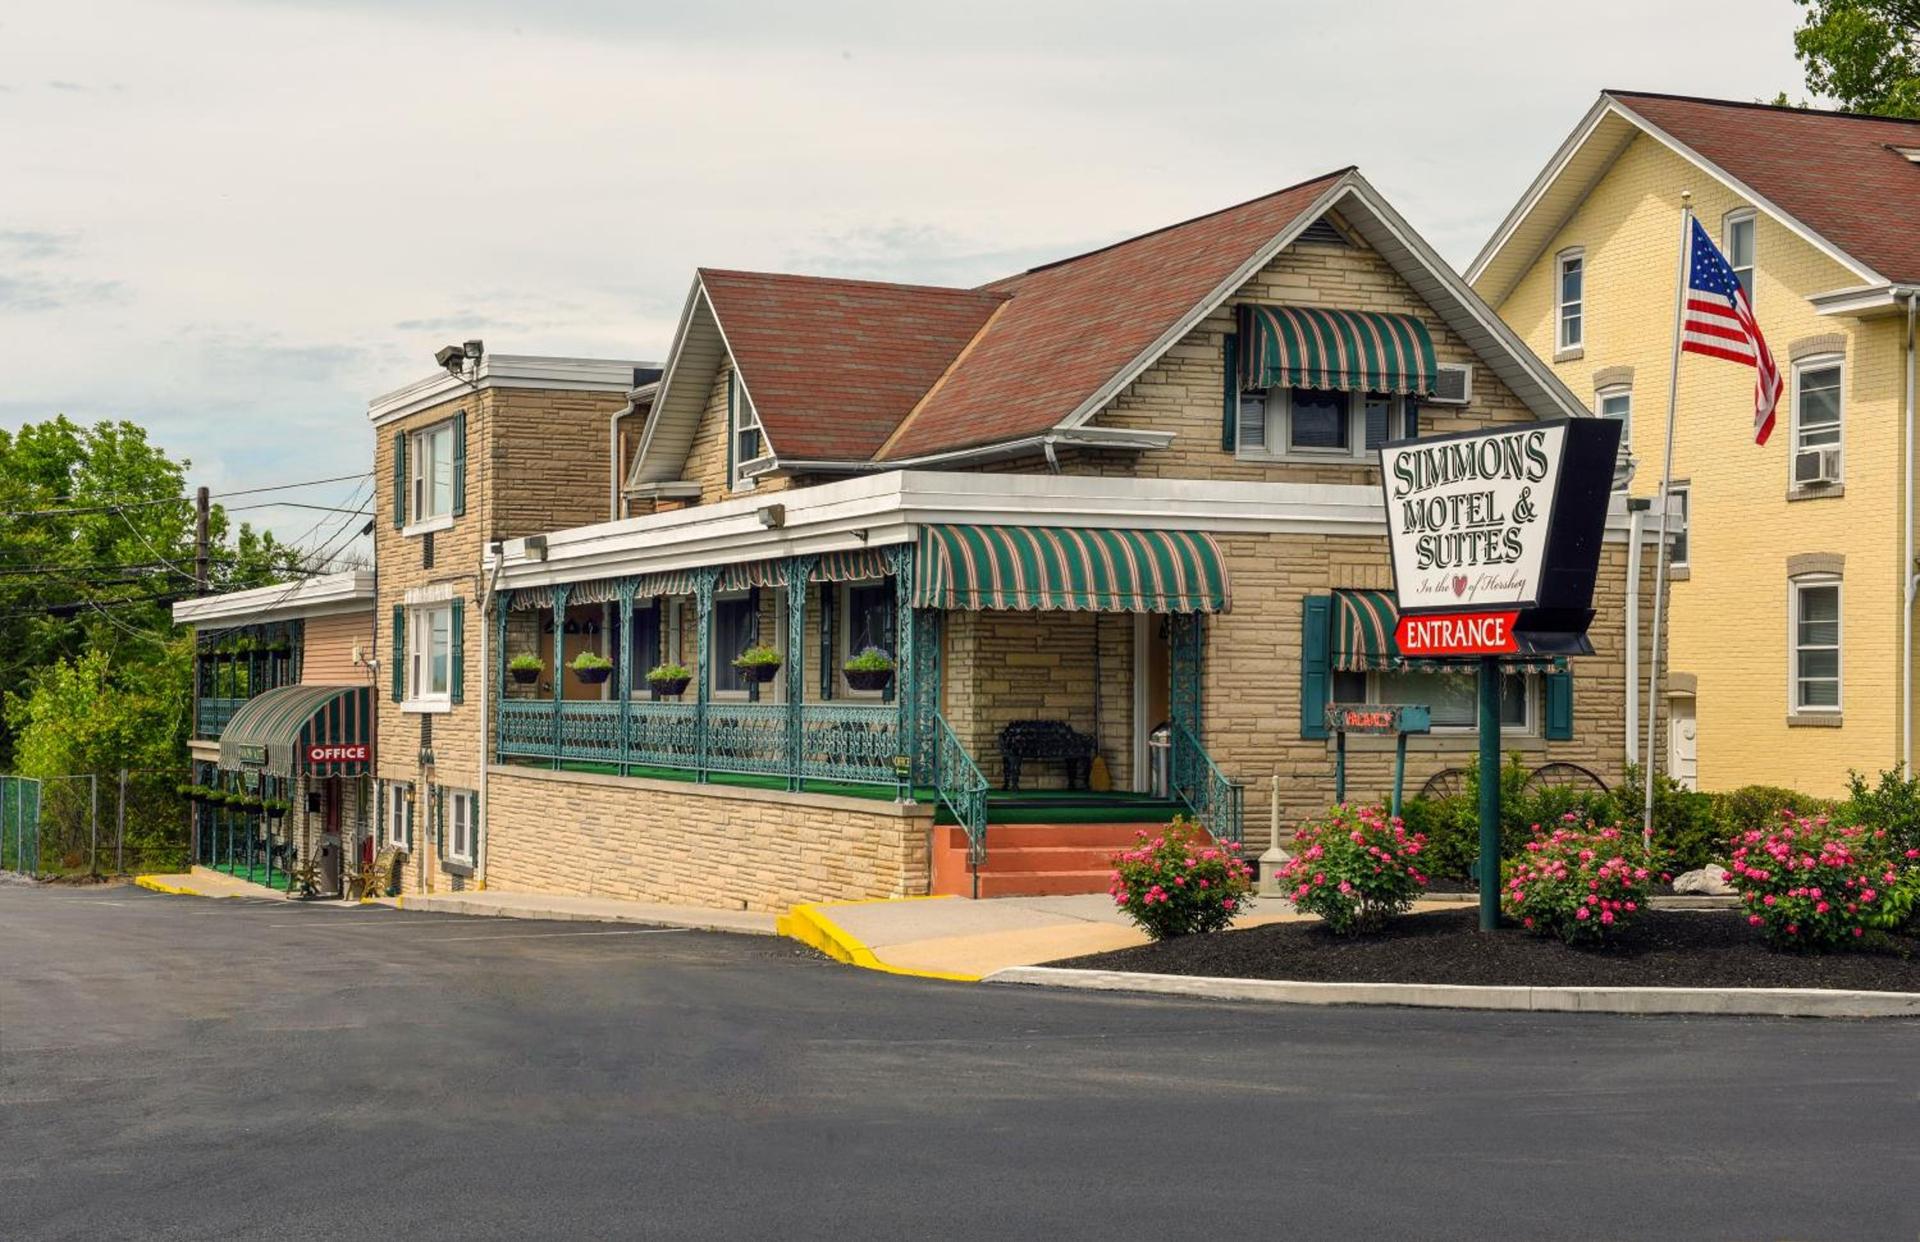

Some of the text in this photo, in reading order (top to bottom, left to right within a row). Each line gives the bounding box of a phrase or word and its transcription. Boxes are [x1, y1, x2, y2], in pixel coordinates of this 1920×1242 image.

[1393, 431, 1548, 500] SIMMONS
[1402, 486, 1538, 534] MOTEL &
[1415, 526, 1523, 570] SUITES
[1416, 569, 1527, 602] In the of Hershey
[1407, 618, 1506, 648] ENTRANCE
[311, 747, 365, 760] OFFICE
